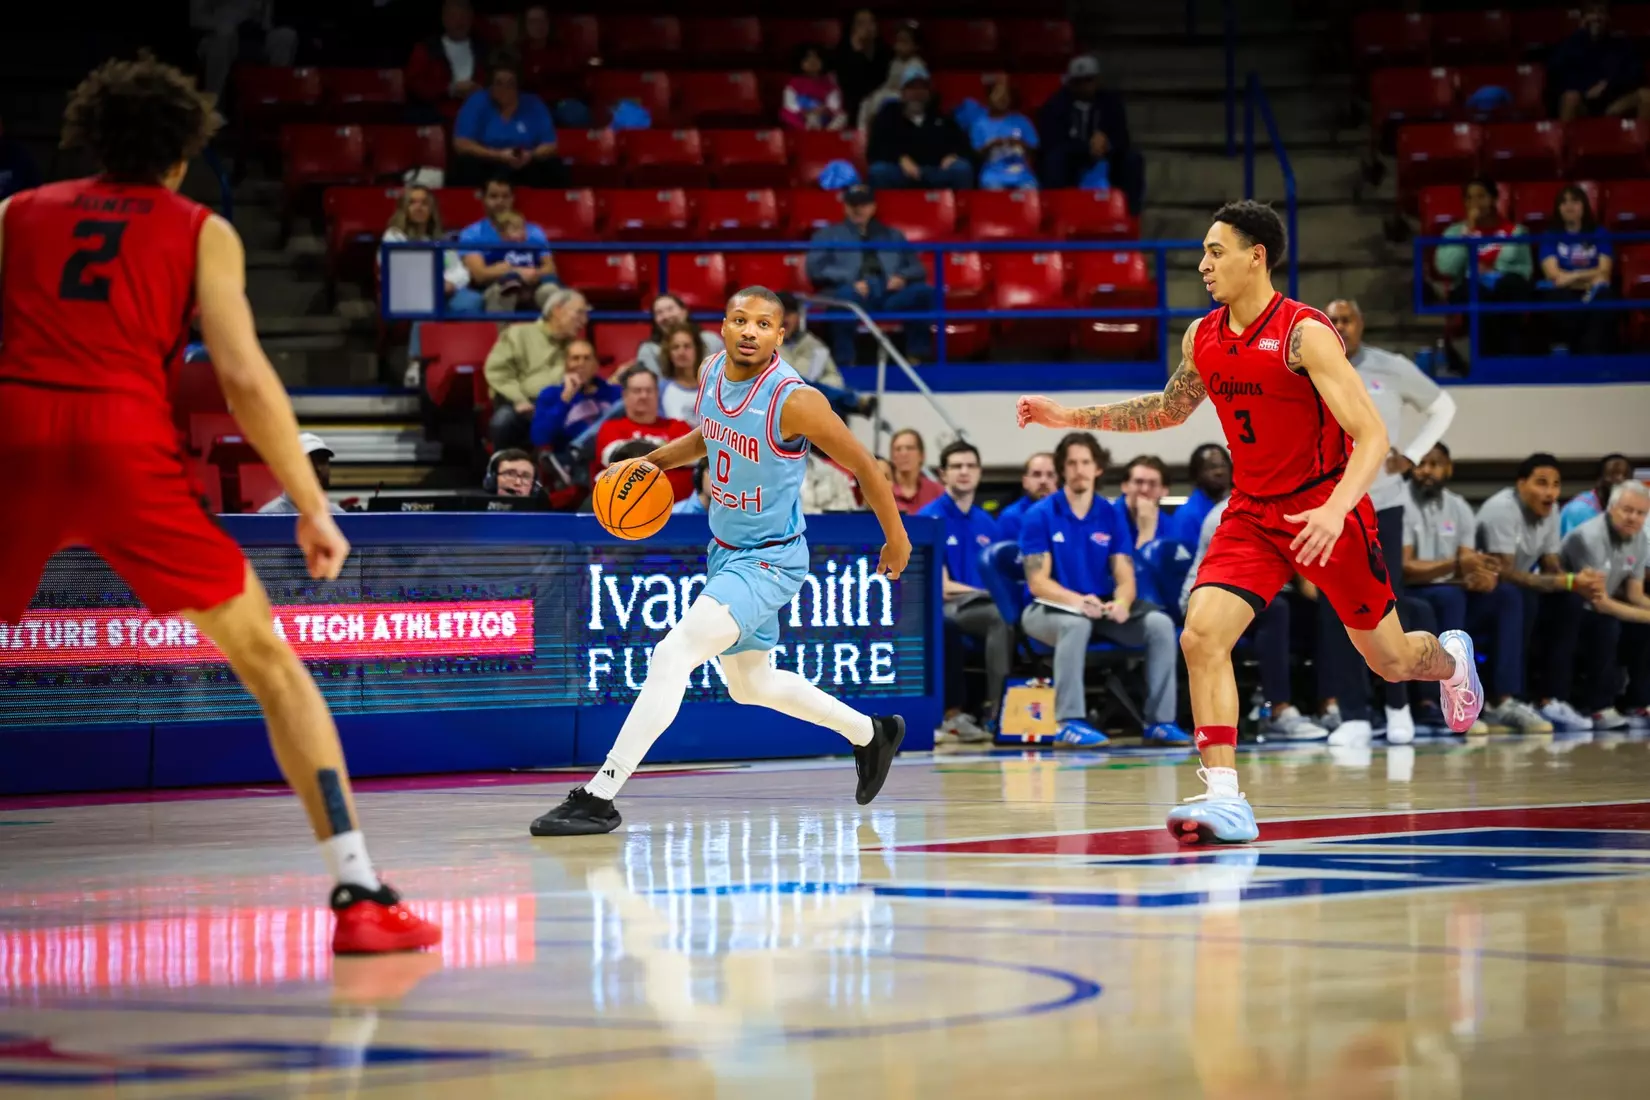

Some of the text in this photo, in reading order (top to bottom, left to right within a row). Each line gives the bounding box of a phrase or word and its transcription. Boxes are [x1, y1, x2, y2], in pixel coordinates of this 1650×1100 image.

[59, 219, 129, 301] 2
[1209, 372, 1264, 403] Cajuns
[1234, 409, 1256, 444] 3
[617, 462, 656, 500] Wilson
[716, 449, 731, 484] 0
[711, 482, 762, 513] ECH
[106, 618, 200, 648] STORE
[294, 615, 364, 642] TECH
[371, 611, 518, 641] ATHLETICS
